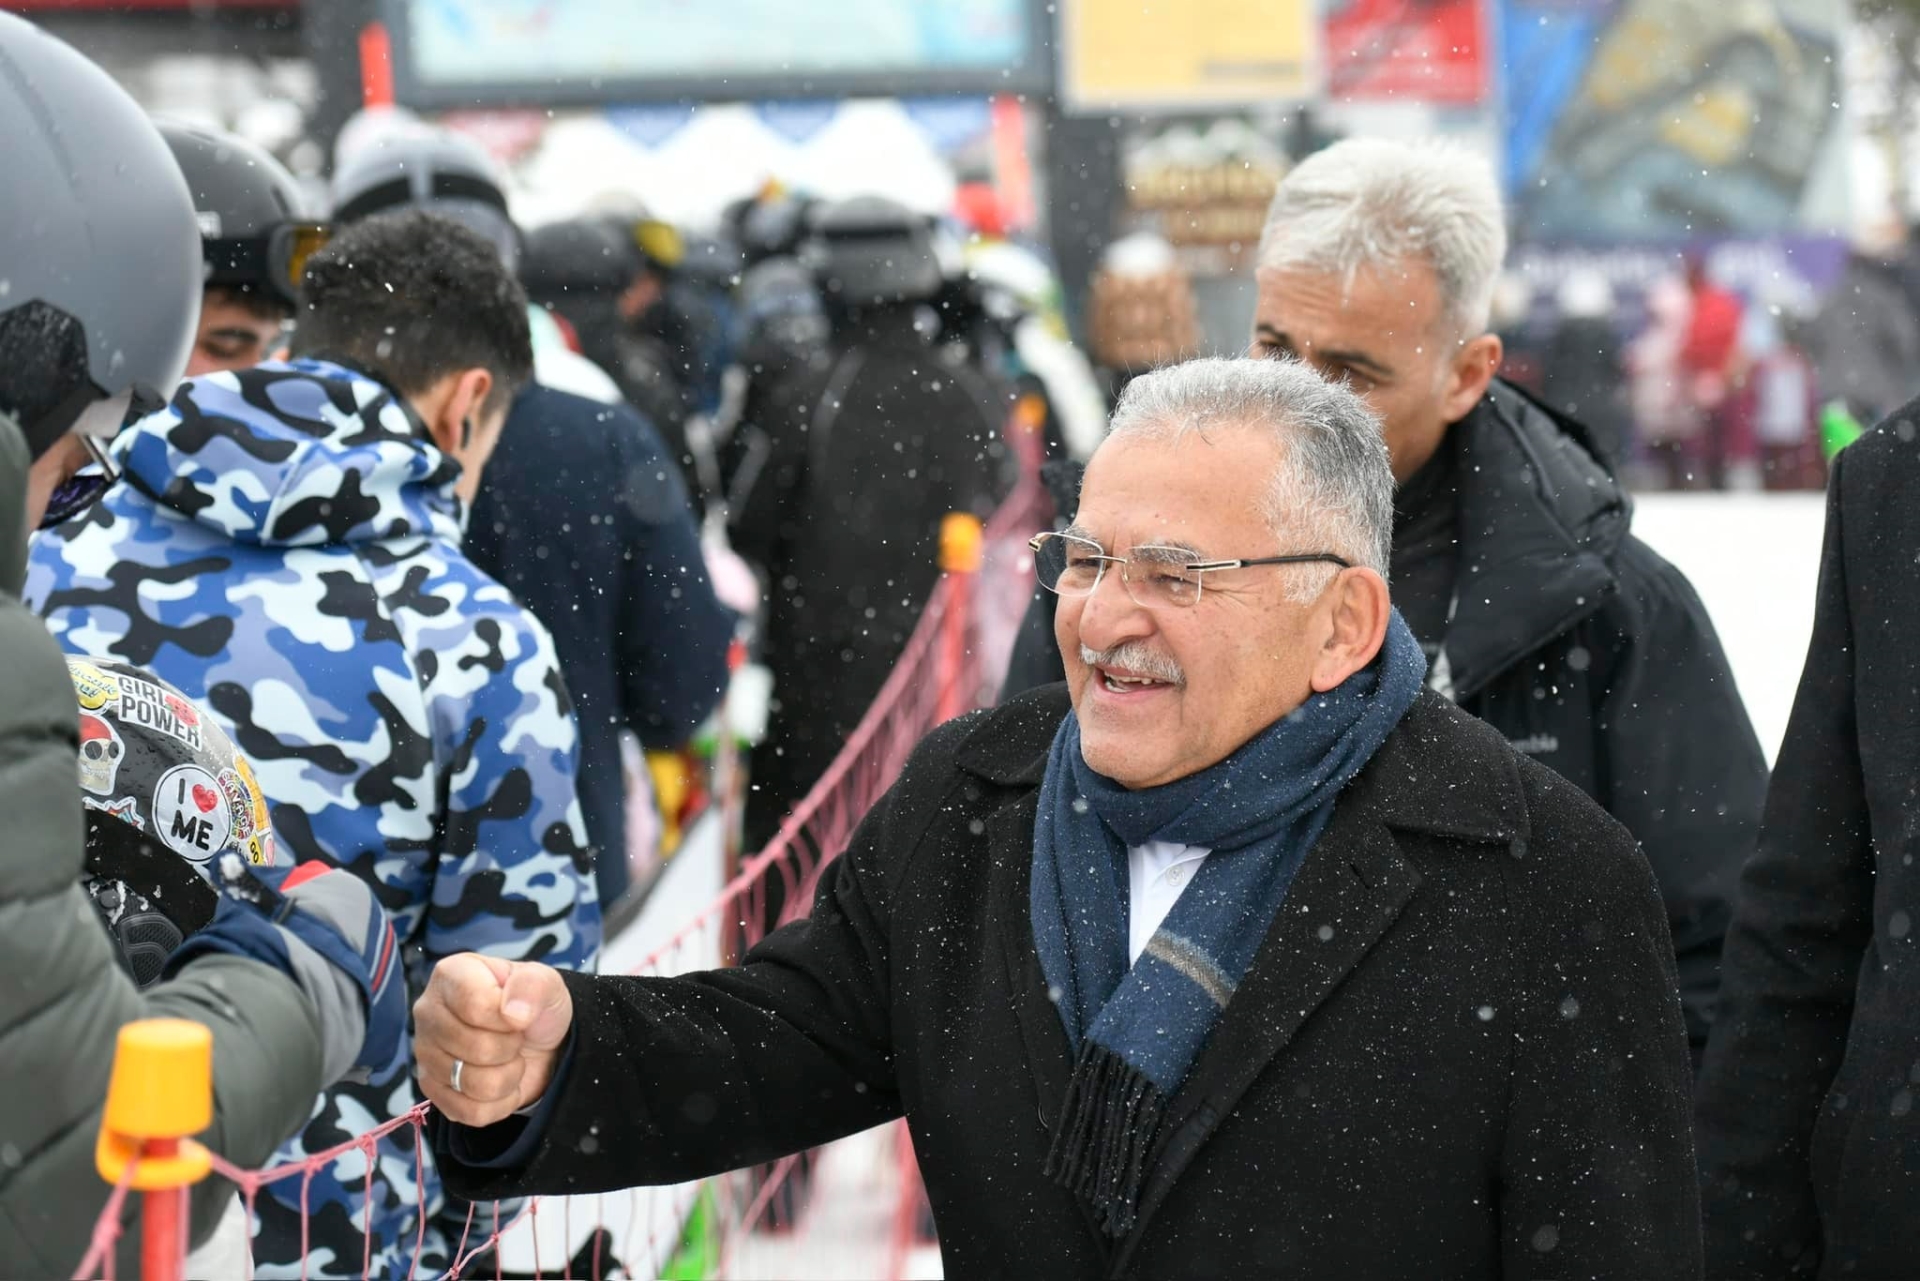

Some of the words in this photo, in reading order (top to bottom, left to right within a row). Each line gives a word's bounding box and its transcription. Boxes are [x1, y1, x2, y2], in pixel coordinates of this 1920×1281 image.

[119, 676, 166, 707] GIRL
[121, 694, 200, 748] POWER
[178, 778, 186, 805] I
[171, 810, 213, 851] ME
